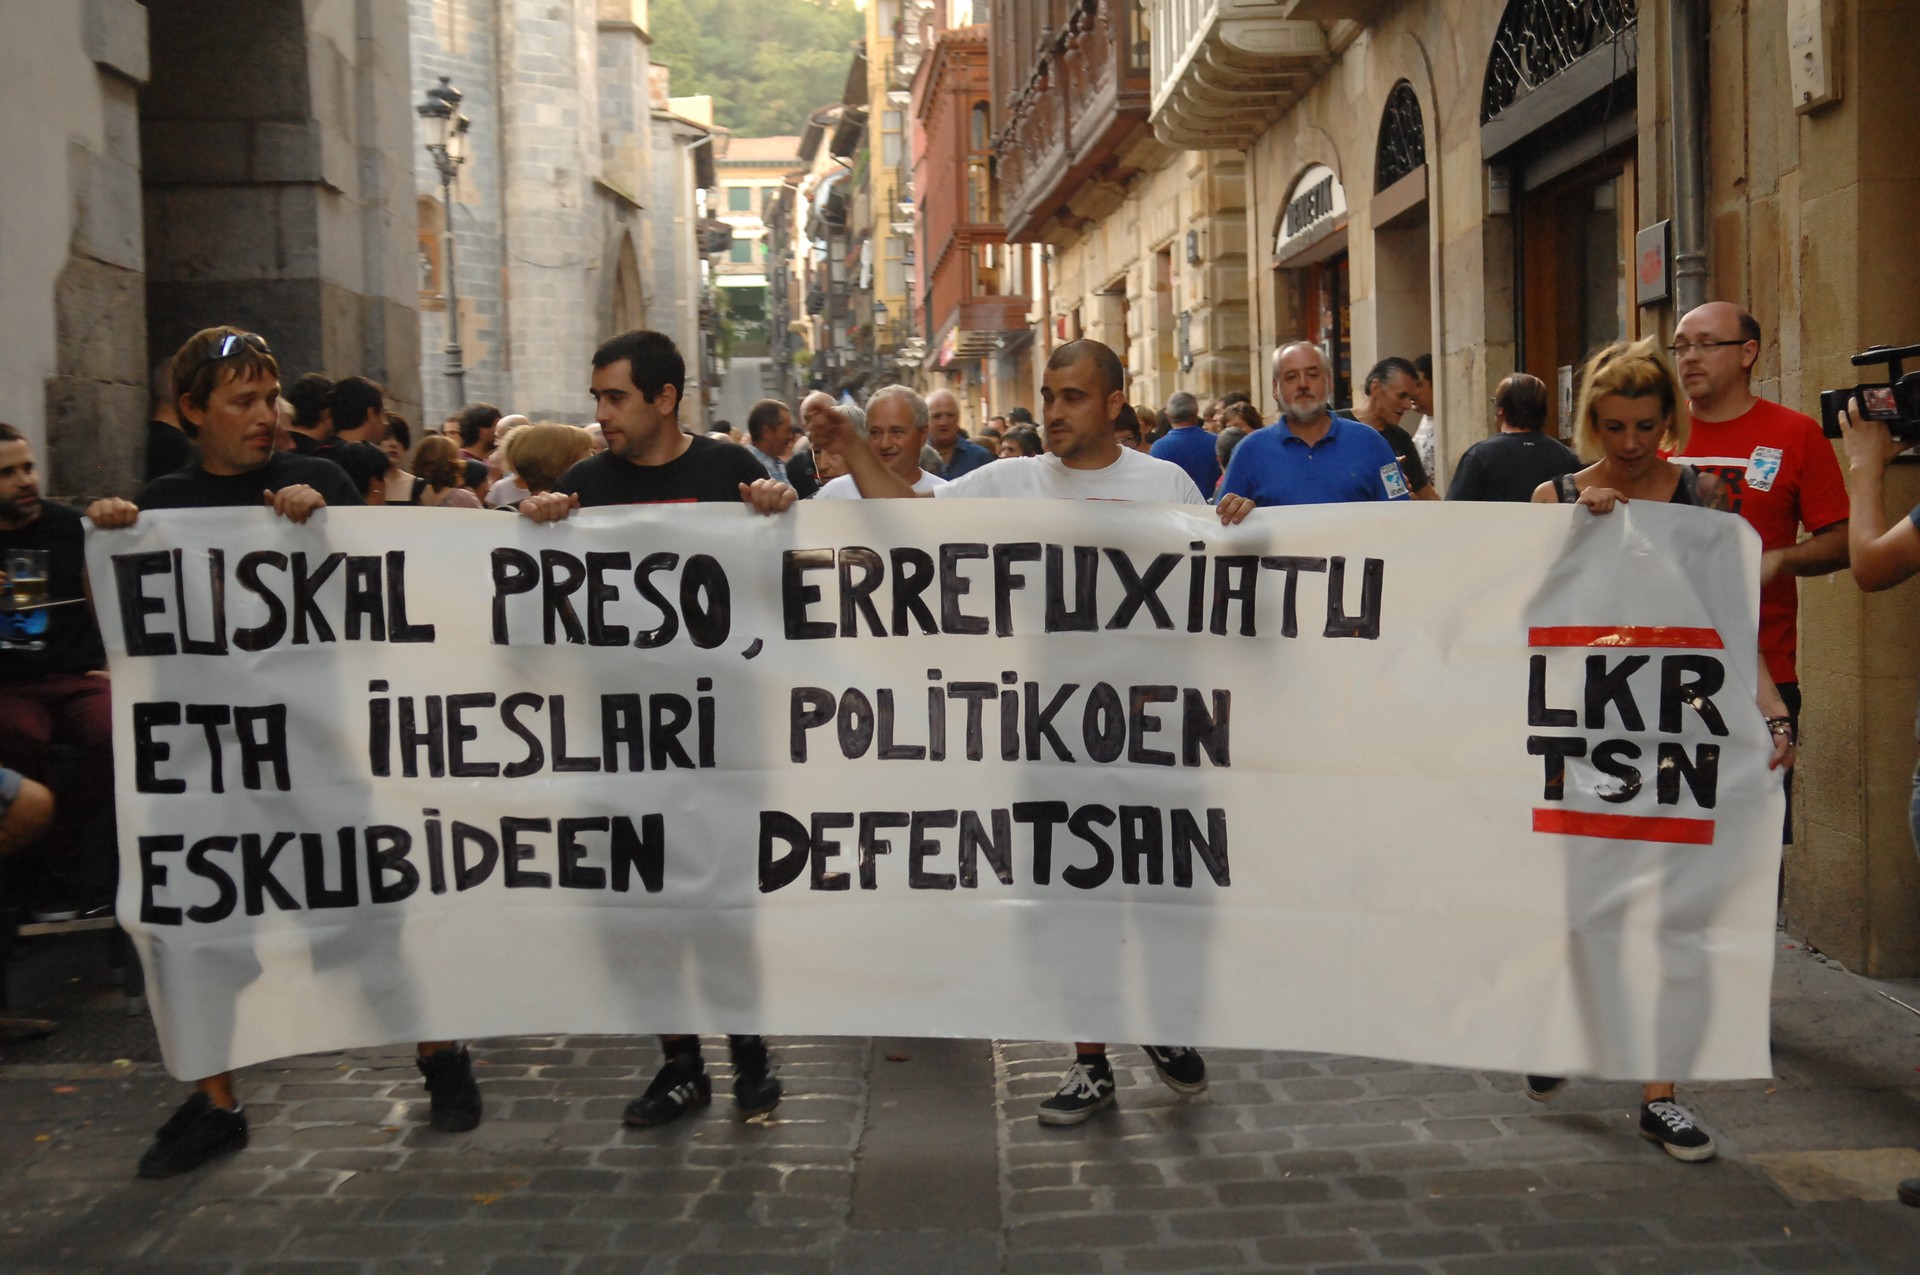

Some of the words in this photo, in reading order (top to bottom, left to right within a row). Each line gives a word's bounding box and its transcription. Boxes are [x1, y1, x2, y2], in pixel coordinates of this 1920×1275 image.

[110, 548, 435, 657] EUSKAL
[491, 547, 763, 660] PRESO,
[1527, 654, 1730, 736] LKR
[133, 701, 291, 795] ETA
[1526, 735, 1721, 810] TSN
[758, 801, 1231, 894] DEFENTSAN
